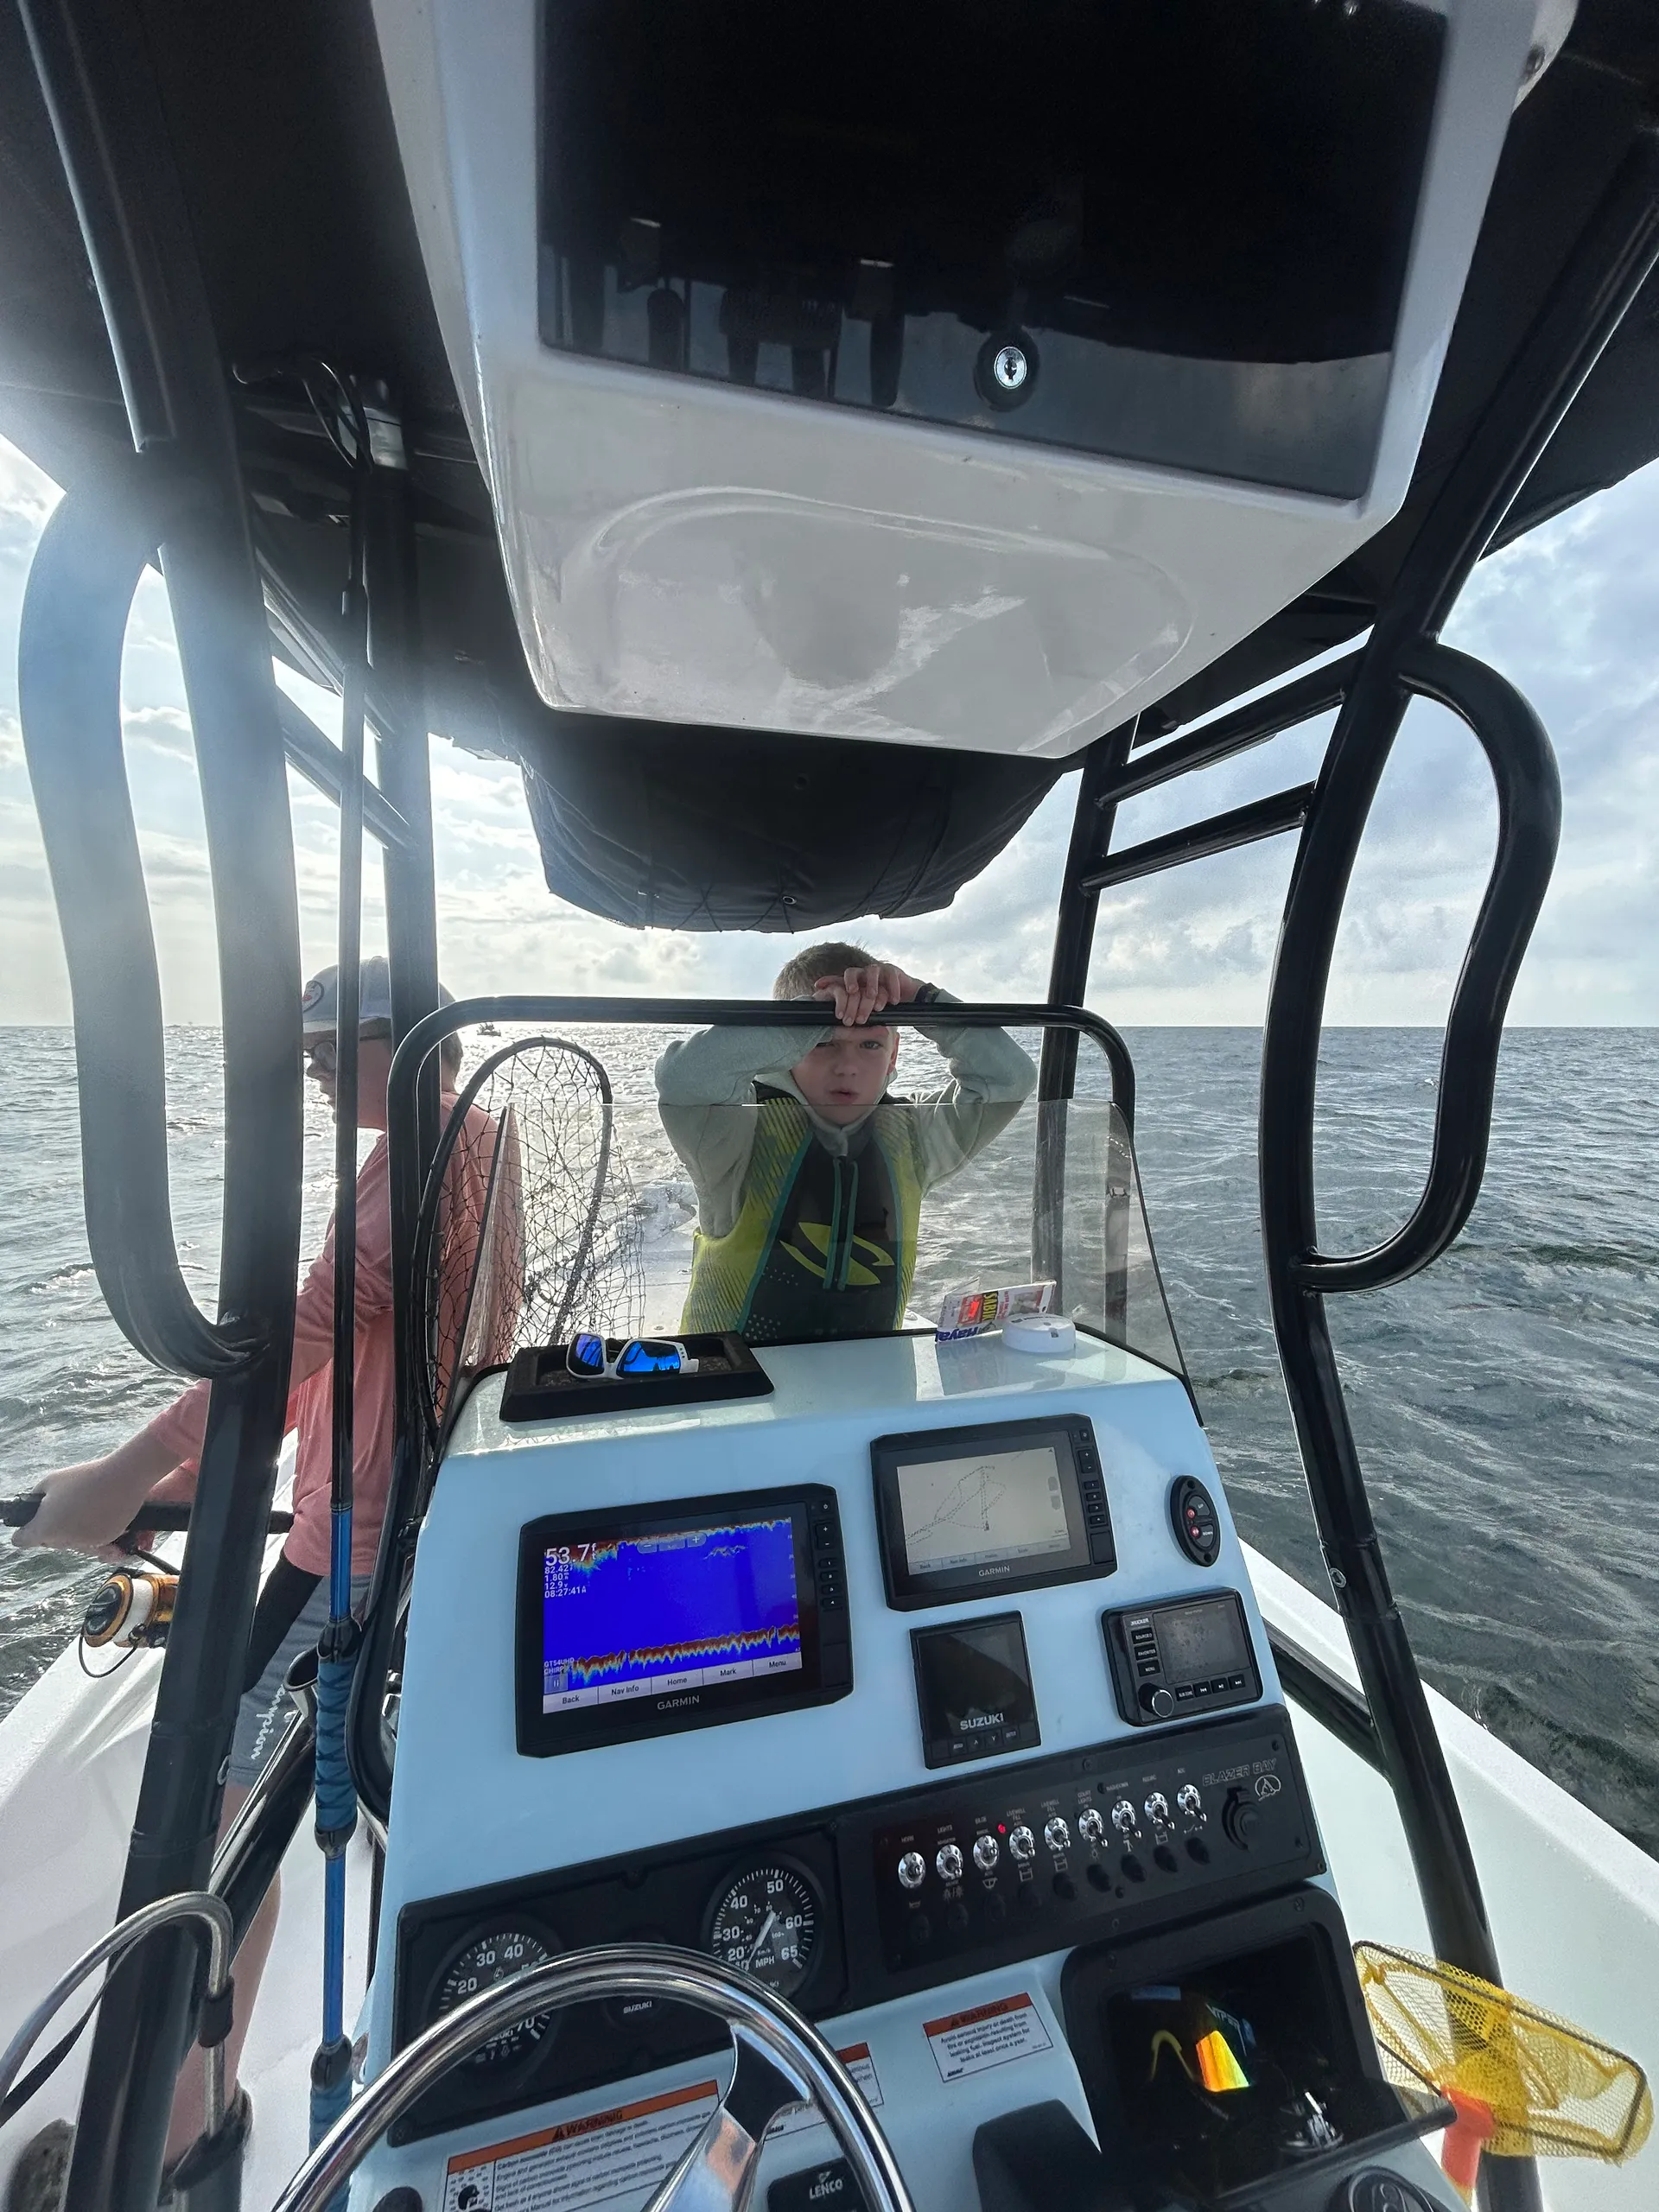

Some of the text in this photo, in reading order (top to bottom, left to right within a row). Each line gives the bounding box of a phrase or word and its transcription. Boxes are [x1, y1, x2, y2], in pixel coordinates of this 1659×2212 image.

[982, 1293, 998, 1320] SABIK
[935, 1327, 978, 1342] Haya
[978, 1565, 1010, 1577] GARMIN
[720, 1668, 736, 1676] Mark
[769, 1660, 786, 1669] Menu
[667, 1677, 687, 1686] Home
[562, 1695, 580, 1704] Back
[611, 1688, 624, 1696] Nav
[657, 1694, 700, 1711] GARMIN
[960, 1713, 1004, 1730] SUZUKI
[1203, 1758, 1276, 1787] BLAZER BAY
[766, 1879, 784, 1893] 50
[730, 1895, 747, 1909] 40
[785, 1915, 803, 1929] 60
[722, 1926, 741, 1941] 30
[476, 1950, 496, 1967] 30
[504, 1943, 524, 1959] 40
[728, 1947, 745, 1961] 20
[781, 1945, 798, 1961] 65
[755, 1955, 775, 1968] MPH
[457, 1978, 478, 1994] 20
[623, 2000, 652, 2014] SUZUKI
[960, 2002, 1008, 2023] WARNING
[940, 2034, 956, 2044] Avoid
[957, 2029, 976, 2038] serious
[976, 2023, 992, 2032] injury
[963, 2032, 989, 2044] explosion
[990, 2024, 1014, 2036] resulting
[950, 2047, 969, 2057] leaking
[982, 2036, 1002, 2047] Inspect
[1002, 2030, 1021, 2040] system
[1014, 2037, 1027, 2046] year.
[566, 2108, 623, 2137] WARNING
[809, 2178, 843, 2201] LENCO
